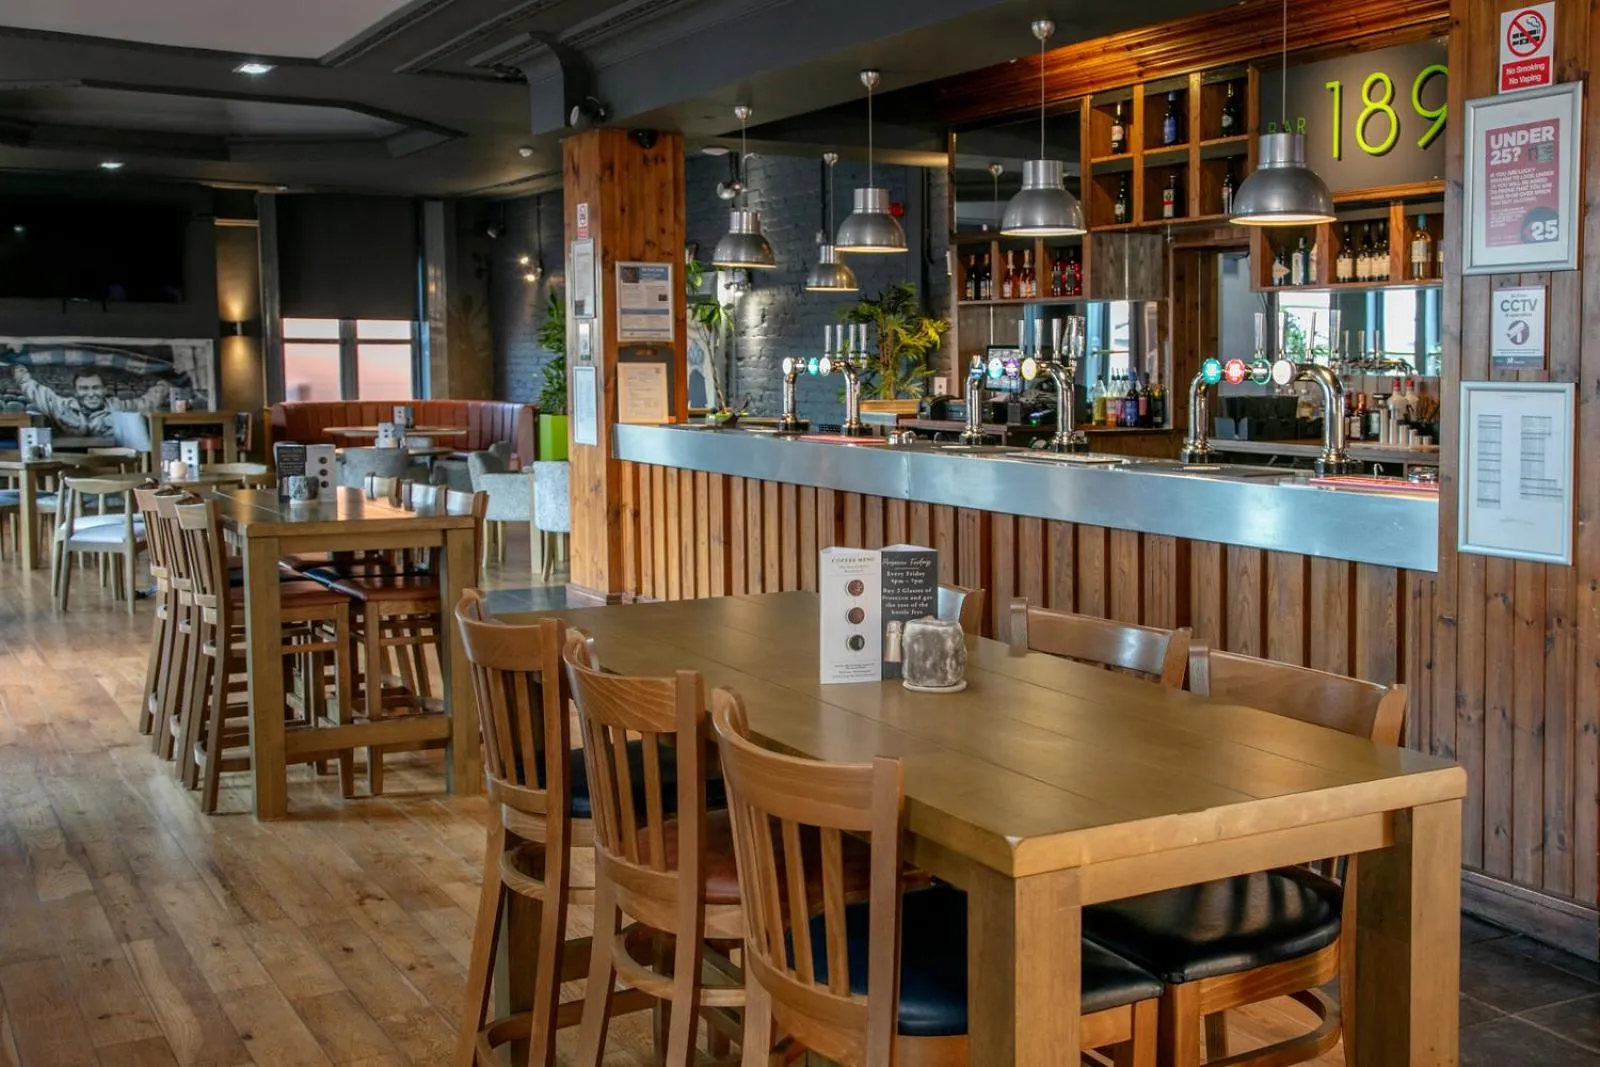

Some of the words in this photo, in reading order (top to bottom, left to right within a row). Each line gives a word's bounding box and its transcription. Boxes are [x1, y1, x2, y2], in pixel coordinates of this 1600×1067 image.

[1516, 62, 1545, 74] Smoking
[1519, 74, 1542, 83] Vaping
[1268, 117, 1307, 135] BAR
[1490, 126, 1555, 149] UNDER
[1490, 147, 1521, 166] 25?
[1531, 219, 1558, 241] 25
[1500, 299, 1538, 312] CCTV
[905, 570, 925, 578] Friday
